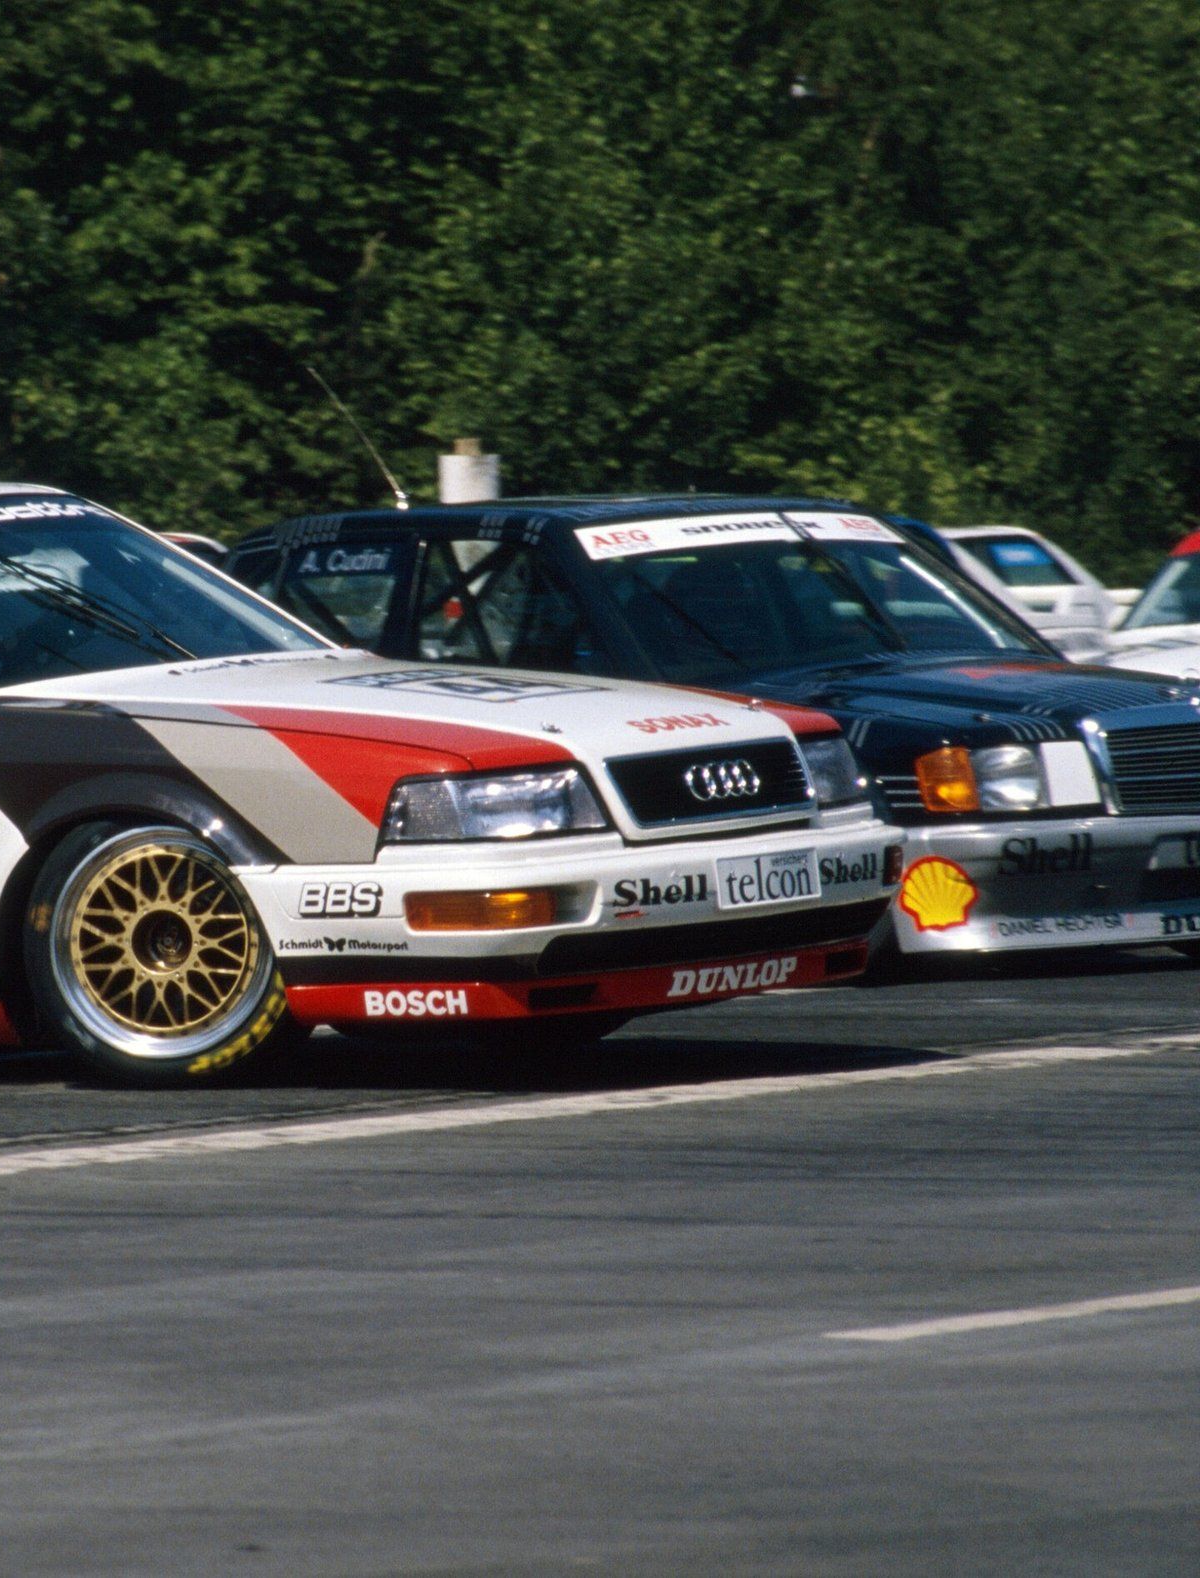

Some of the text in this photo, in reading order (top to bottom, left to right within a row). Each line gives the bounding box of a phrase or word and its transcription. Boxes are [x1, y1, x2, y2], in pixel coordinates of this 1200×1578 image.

[591, 530, 649, 548] AEG
[626, 713, 731, 734] SONAX
[725, 858, 814, 905] telcon
[818, 853, 877, 885] Shell
[298, 882, 384, 919] BBS
[612, 874, 708, 907] Shell
[278, 938, 409, 952] Schmidt Motorsport
[667, 956, 798, 997] DUNLOP
[363, 990, 469, 1016] BOSCH
